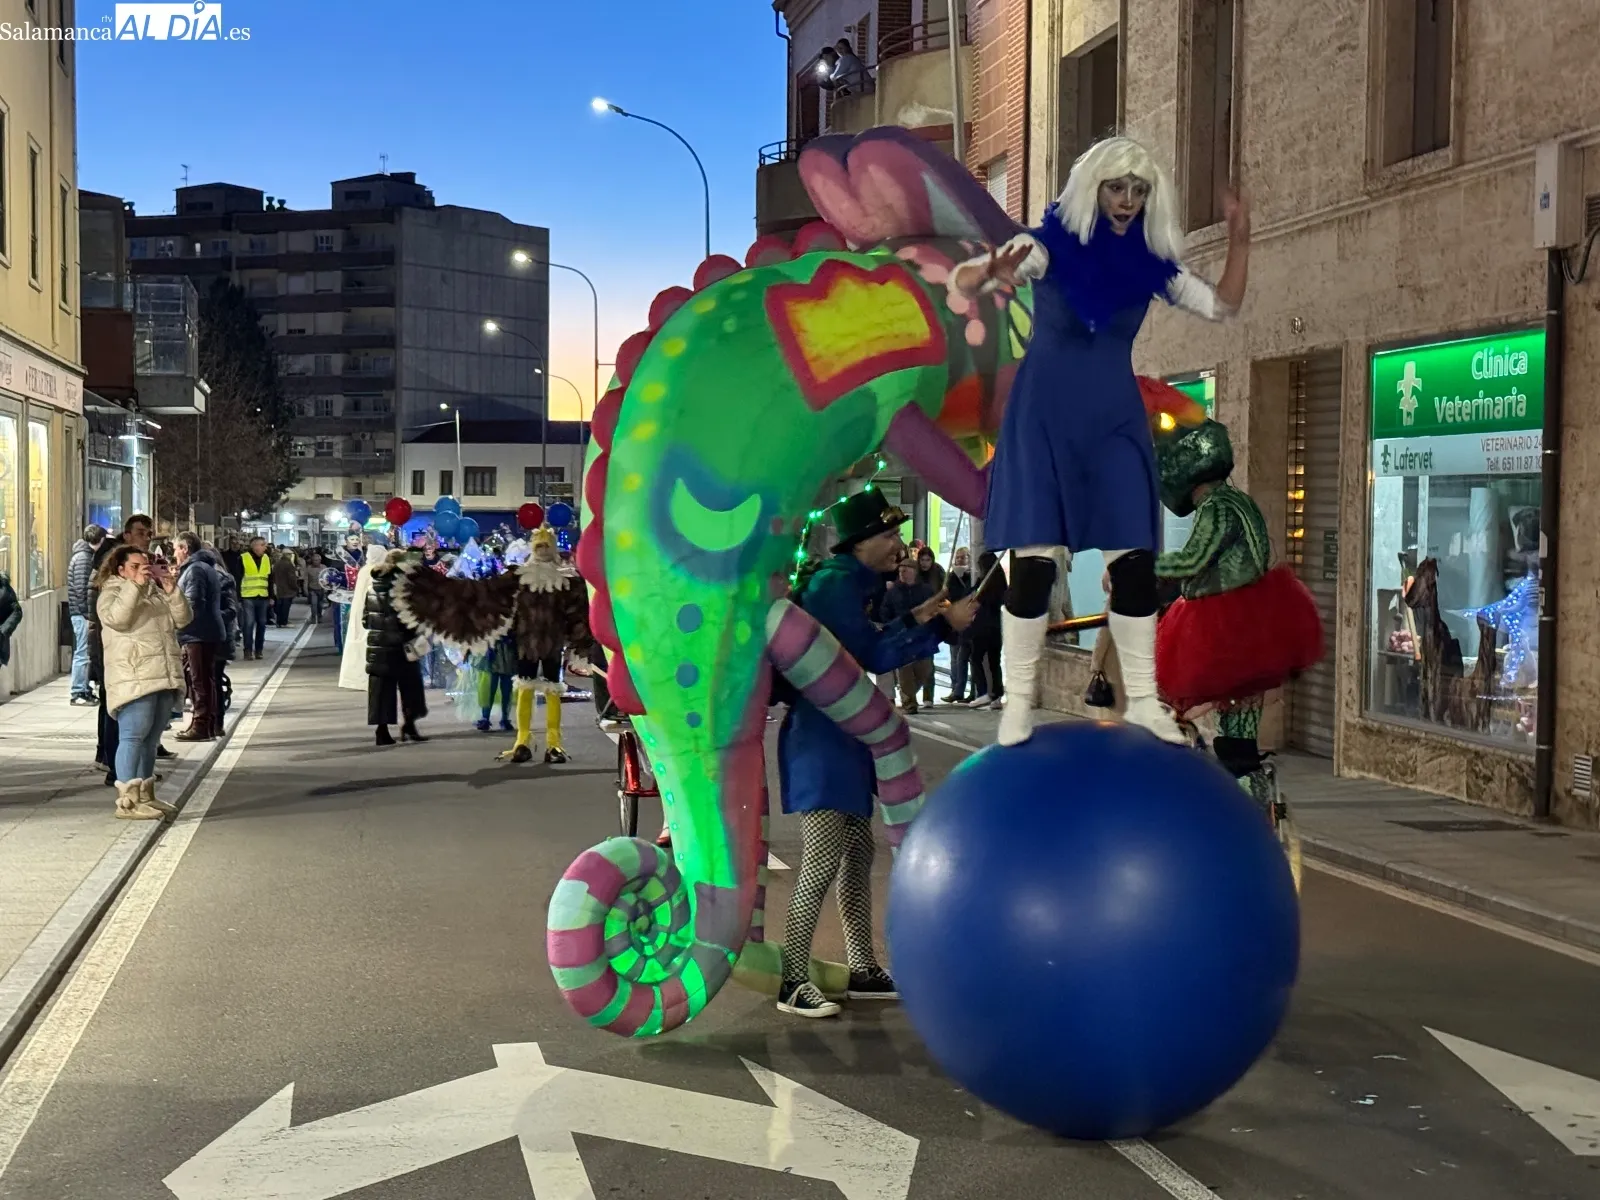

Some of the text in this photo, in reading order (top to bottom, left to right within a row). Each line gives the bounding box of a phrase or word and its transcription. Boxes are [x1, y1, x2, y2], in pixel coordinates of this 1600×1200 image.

[1471, 345, 1528, 380] Clínica
[1434, 387, 1527, 424] Veterinaria
[1480, 435, 1532, 453] VETERINARIO
[1393, 446, 1433, 471] Lafervet
[1524, 455, 1533, 470] 87
